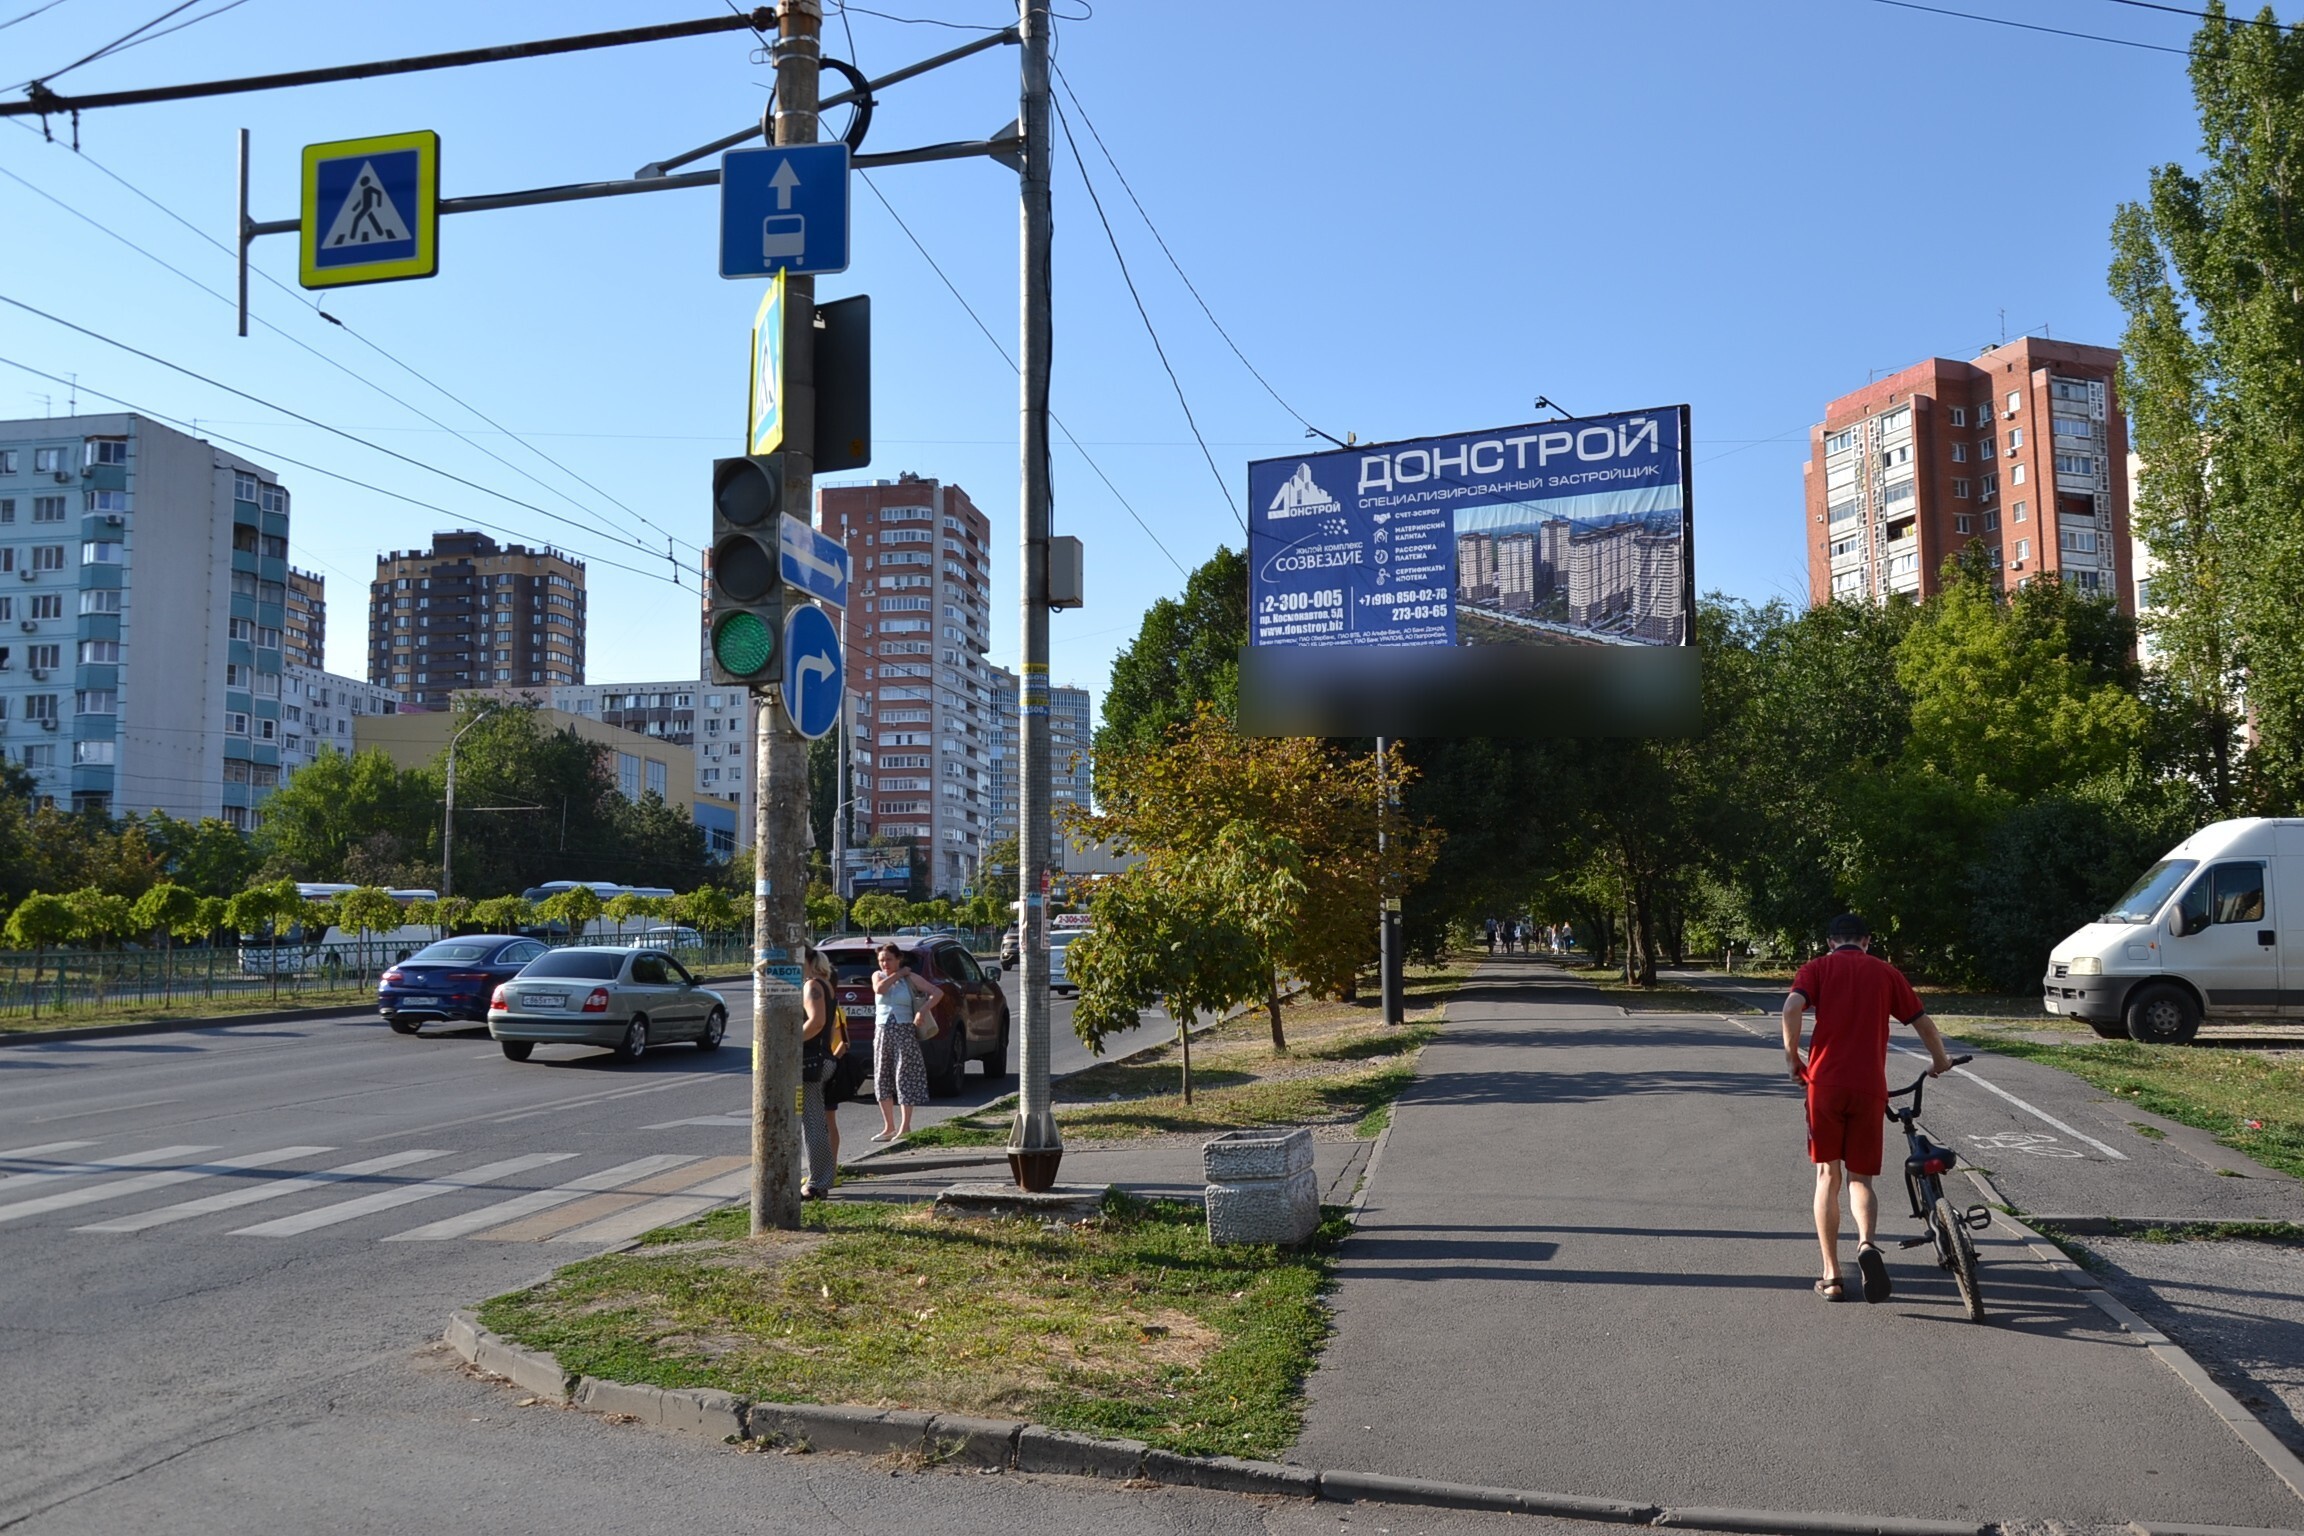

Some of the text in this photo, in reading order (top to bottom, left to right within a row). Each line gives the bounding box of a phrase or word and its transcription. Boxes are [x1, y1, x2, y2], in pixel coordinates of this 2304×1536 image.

[1358, 417, 1659, 496] ДОНСТРОЙ
[1358, 464, 1660, 508] СПЕЦИАЛИЗИРОВАННЫЙ ЗАСТРОЙЩИК
[1394, 508, 1440, 519] СЧЕТ-ЭСКРОУ
[1395, 520, 1446, 533] МАТЕРИНСКИЙ
[1395, 532, 1427, 541] КАПИТАЛ
[1395, 544, 1437, 554] РАССРОЧКА
[1276, 550, 1363, 572] СОЗВЕЗДИЕ
[1395, 553, 1427, 561] ПЛАТЕЖА
[1396, 564, 1445, 575] СЕРТИФИКАТЫ
[1396, 574, 1427, 582] ИПОТЕКА
[1265, 589, 1343, 612] 2-300-005
[1359, 588, 1448, 606] +7 (918) 850-02-78
[1260, 608, 1344, 625] пр. Космонавтов, 5Д
[1392, 604, 1448, 621] 273-03-65
[1260, 620, 1344, 637] www.donstroy.biz
[766, 967, 801, 977] РАБОТА
